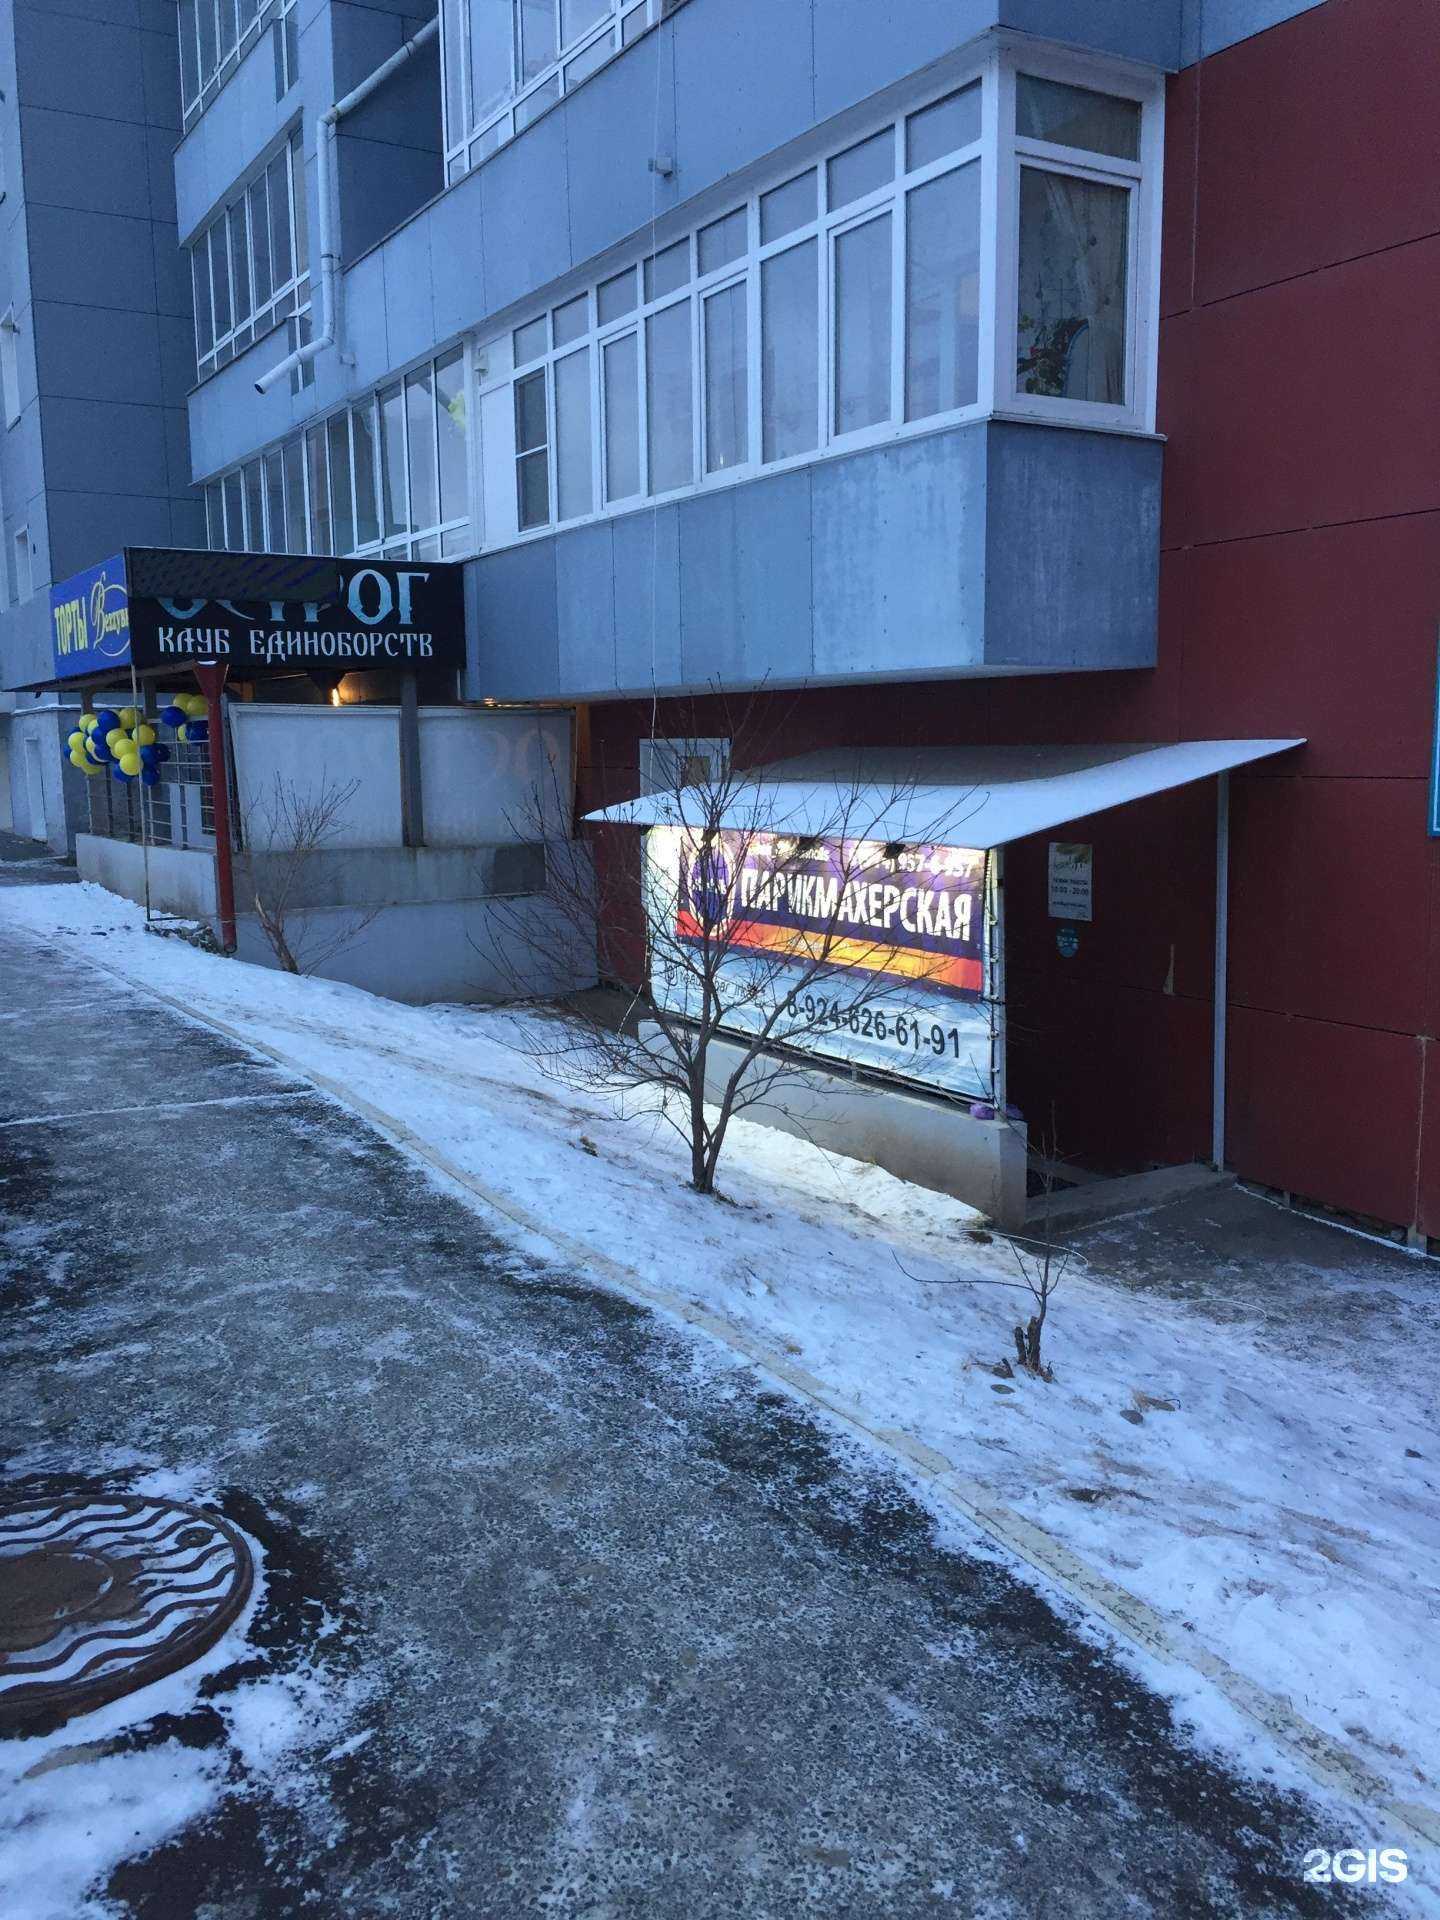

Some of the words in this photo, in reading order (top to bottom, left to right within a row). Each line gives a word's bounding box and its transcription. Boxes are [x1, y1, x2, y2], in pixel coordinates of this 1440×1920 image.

[54, 596, 88, 656] ТОРТЫ
[158, 626, 231, 654] КЛУБ
[249, 629, 434, 664] ЕДИНОБОРСТВ
[740, 867, 973, 941] ПАРИКМАХЕРСКАЯ
